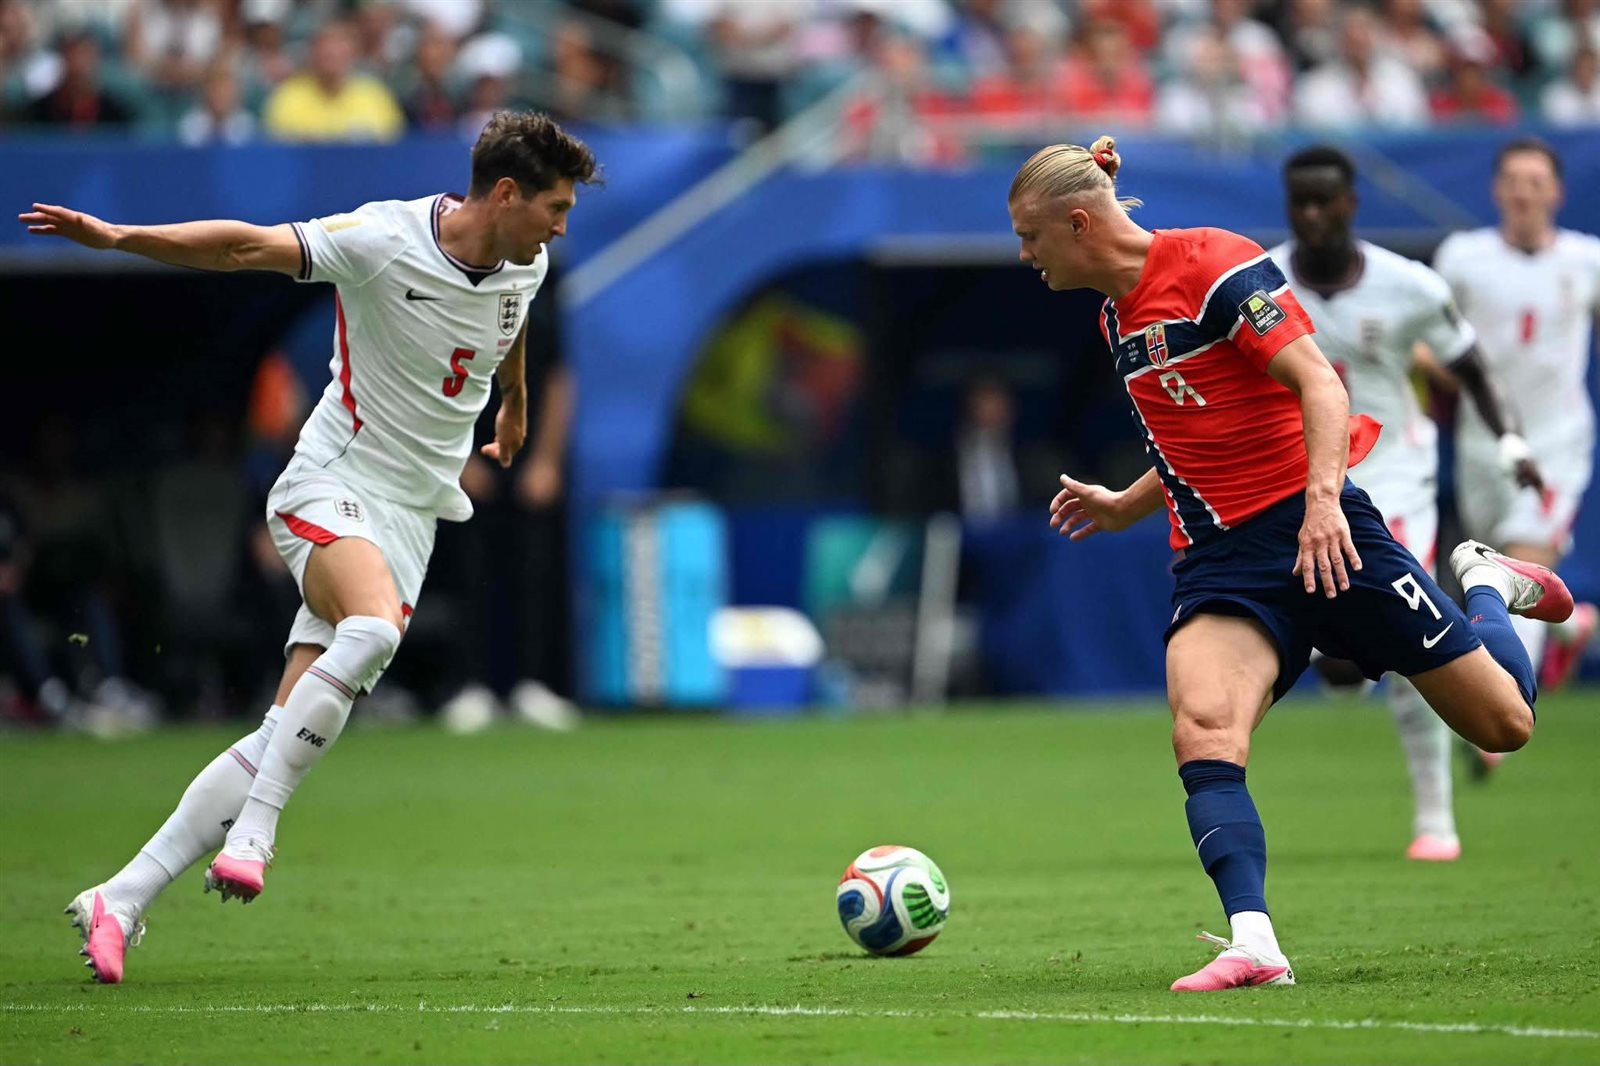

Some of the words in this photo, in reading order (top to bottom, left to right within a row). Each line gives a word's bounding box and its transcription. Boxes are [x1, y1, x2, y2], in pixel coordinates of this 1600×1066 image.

[442, 347, 476, 397] 5
[1159, 369, 1207, 407] 9
[1391, 572, 1442, 620] 9
[296, 727, 326, 748] ENG
